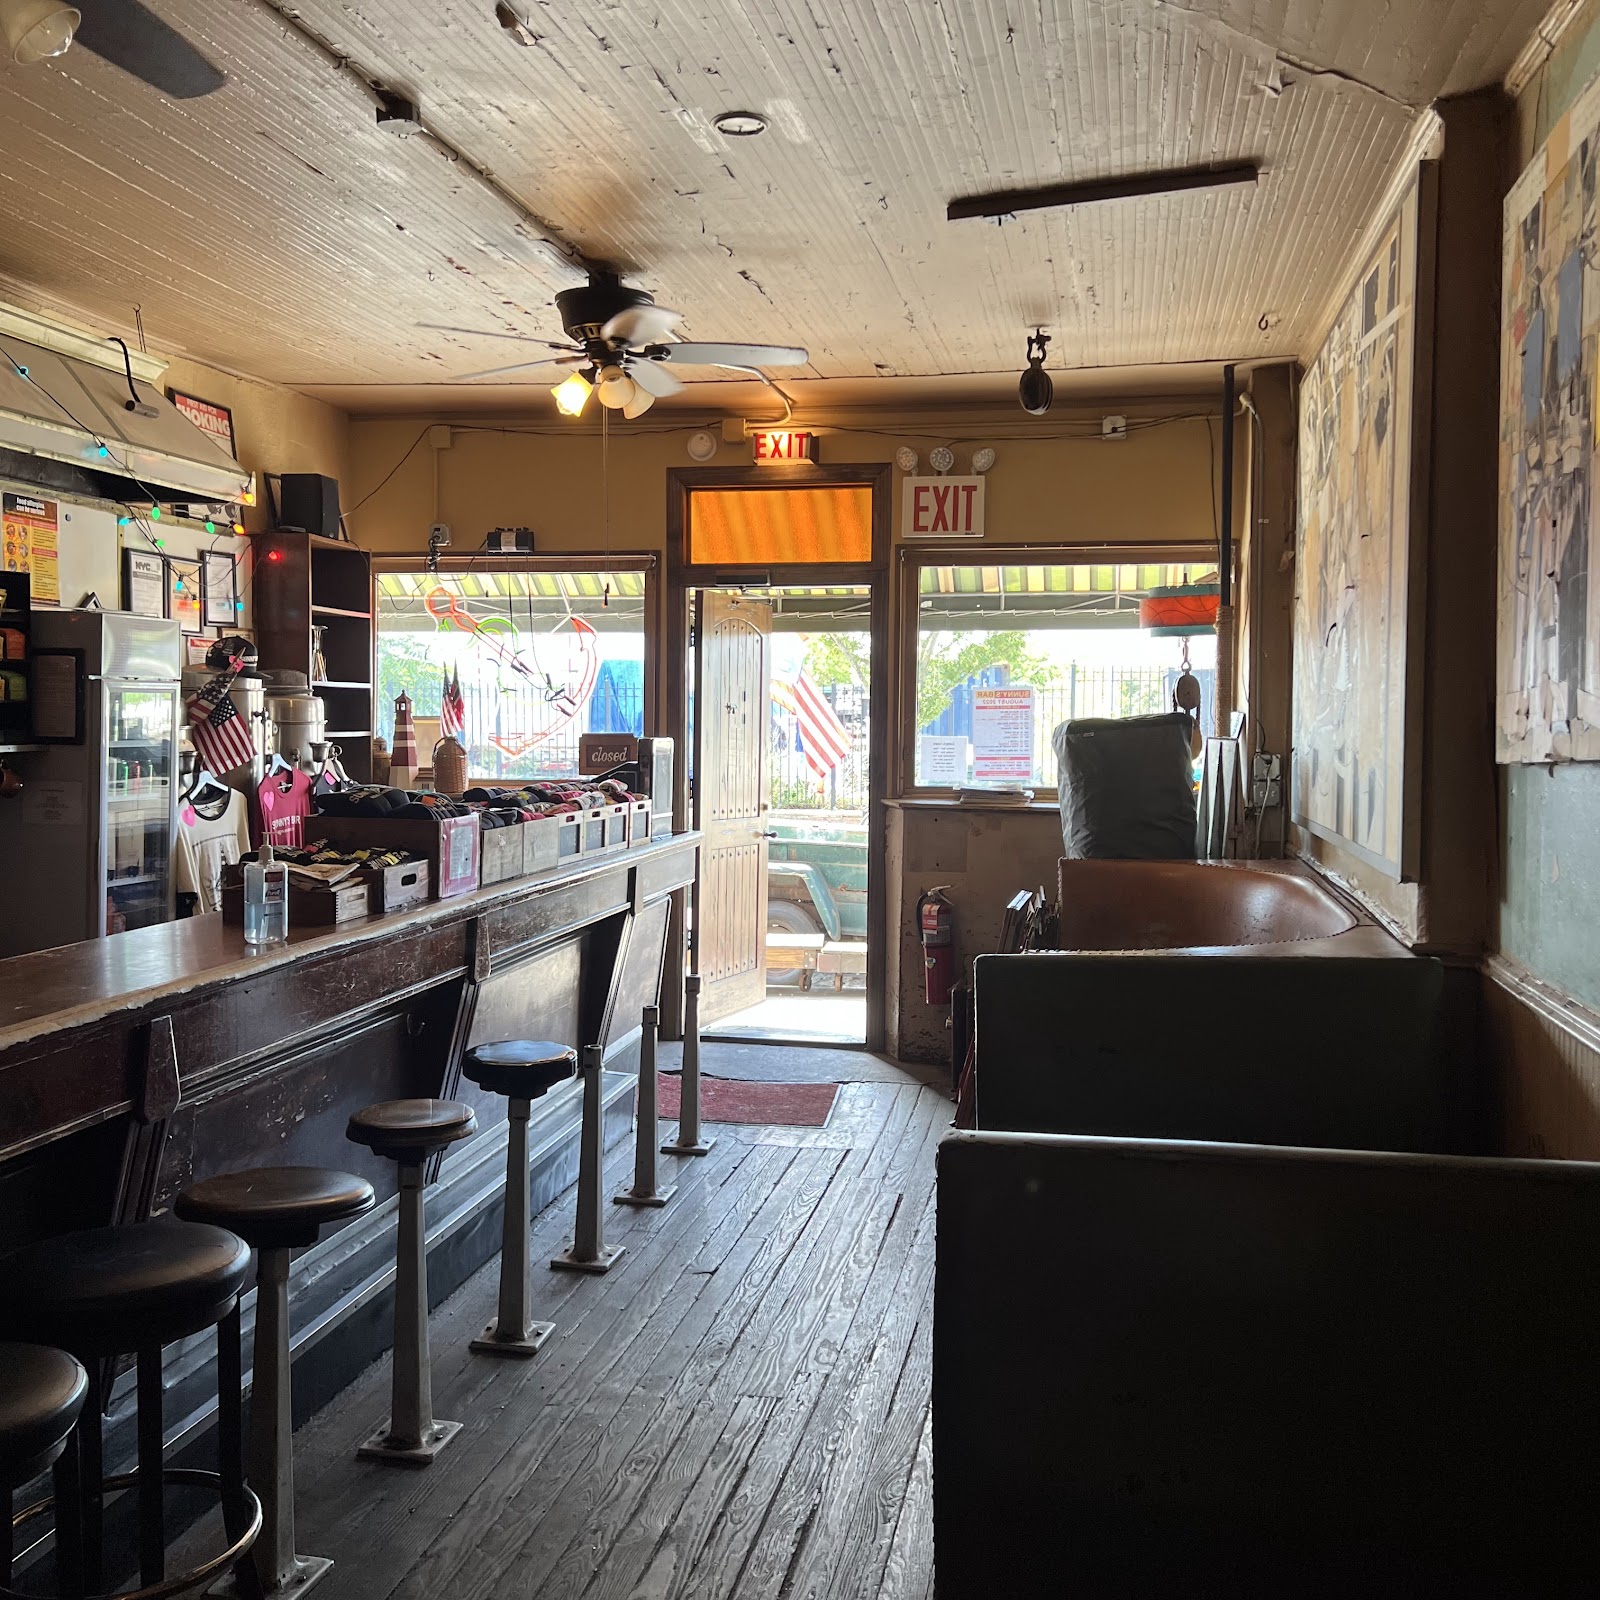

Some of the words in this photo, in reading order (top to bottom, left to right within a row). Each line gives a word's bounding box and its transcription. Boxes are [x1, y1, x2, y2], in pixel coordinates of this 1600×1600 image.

[756, 433, 809, 459] EXIT
[913, 485, 978, 532] EXIT
[135, 560, 151, 571] NYC
[591, 747, 628, 762] closed
